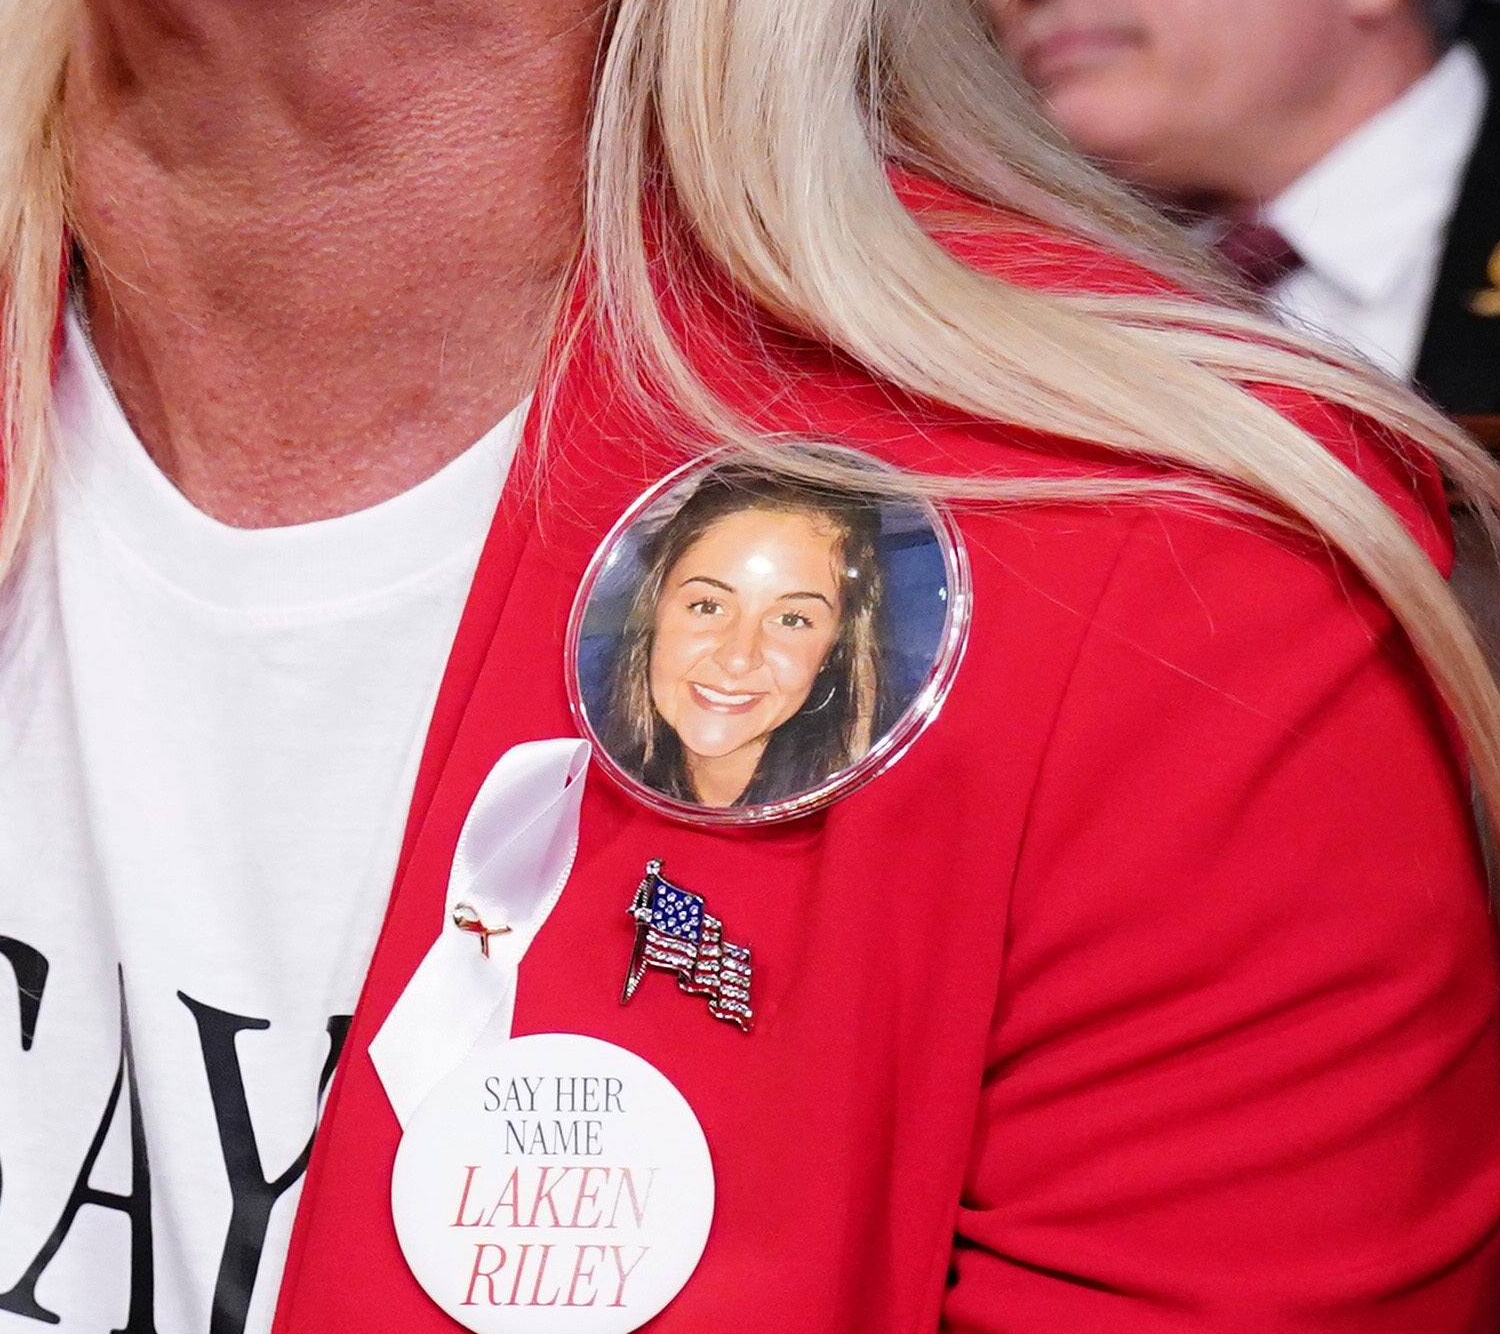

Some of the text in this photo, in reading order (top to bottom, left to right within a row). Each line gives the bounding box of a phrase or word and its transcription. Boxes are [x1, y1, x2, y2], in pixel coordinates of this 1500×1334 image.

[483, 1075, 627, 1114] SAY HER
[504, 1119, 603, 1156] NAME
[449, 1165, 661, 1230] LAKEN
[459, 1243, 652, 1308] RILEY
